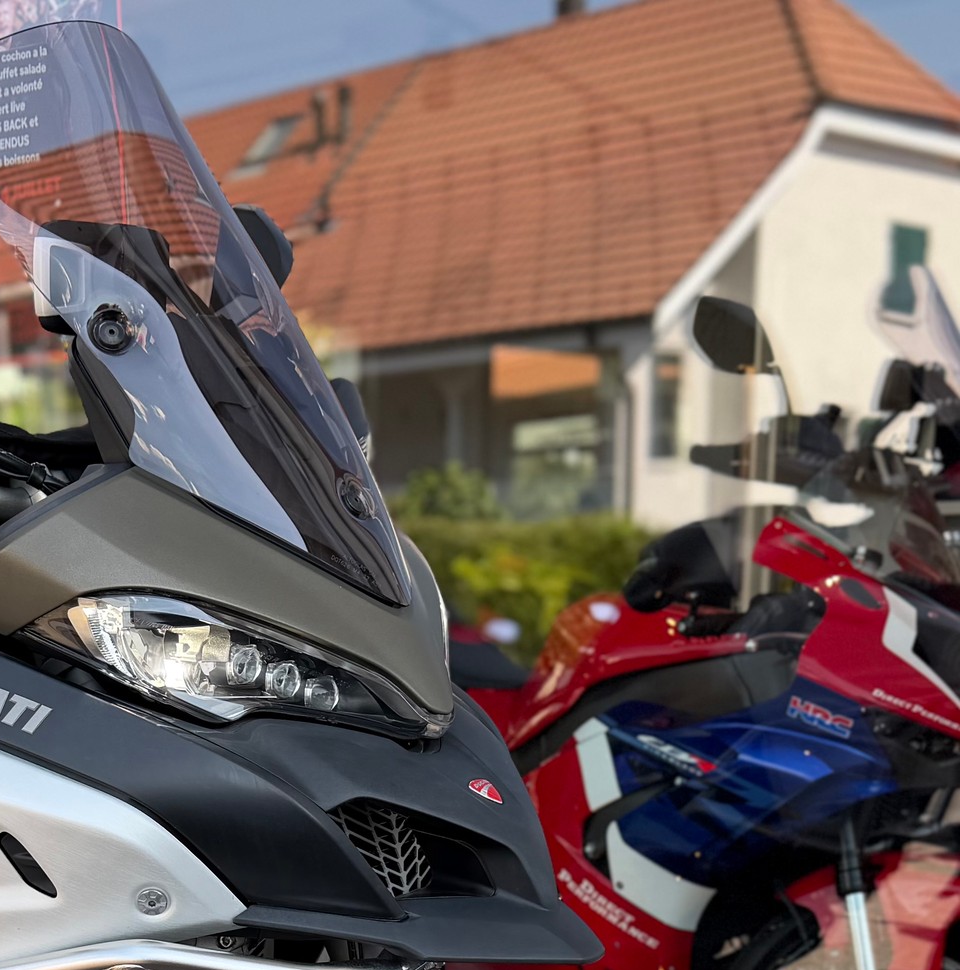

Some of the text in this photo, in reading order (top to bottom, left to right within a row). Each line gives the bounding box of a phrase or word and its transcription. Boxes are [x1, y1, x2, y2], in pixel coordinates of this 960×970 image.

[1, 50, 31, 62] cochon
[40, 46, 48, 57] la
[20, 62, 46, 76] salade
[11, 78, 43, 95] volonté
[10, 100, 26, 113] live
[3, 117, 28, 132] BACK
[29, 115, 39, 127] et
[3, 153, 40, 167] boissons
[786, 695, 854, 739] HRC
